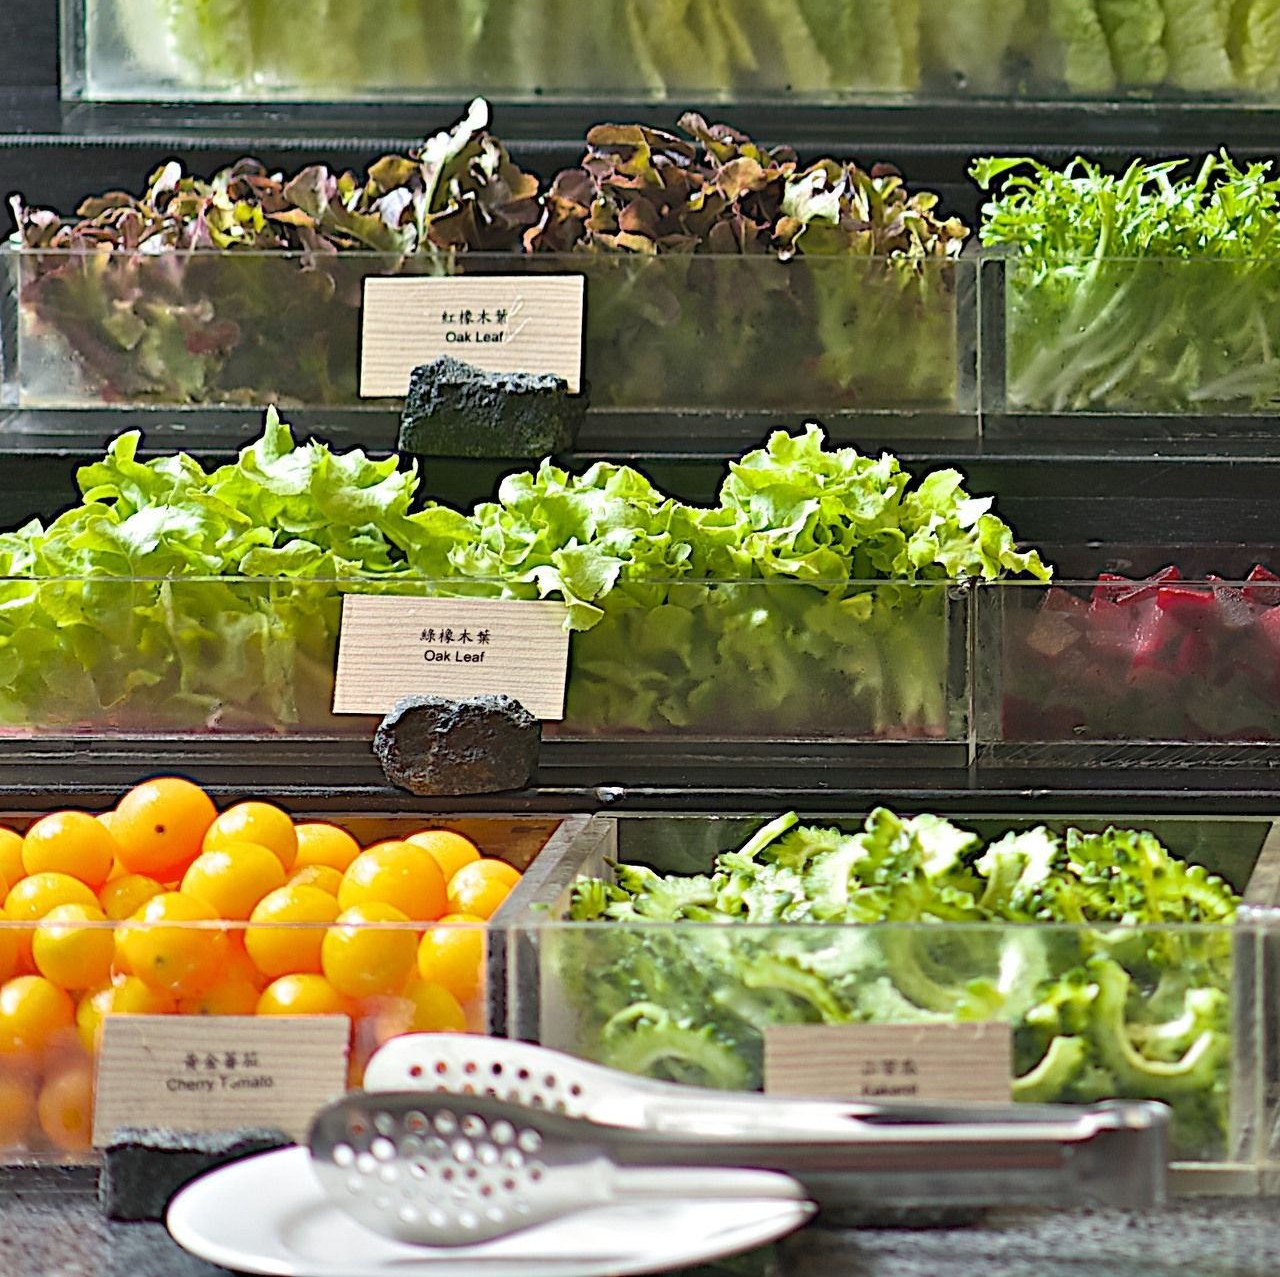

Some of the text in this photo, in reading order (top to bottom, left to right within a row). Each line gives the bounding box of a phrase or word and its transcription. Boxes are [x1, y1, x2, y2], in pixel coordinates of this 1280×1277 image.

[445, 331, 504, 342] Oak Leaf
[420, 628, 491, 645] 綠橡木葉
[424, 650, 485, 662] Oak Leaf
[166, 1075, 273, 1092] Cherry Tomato
